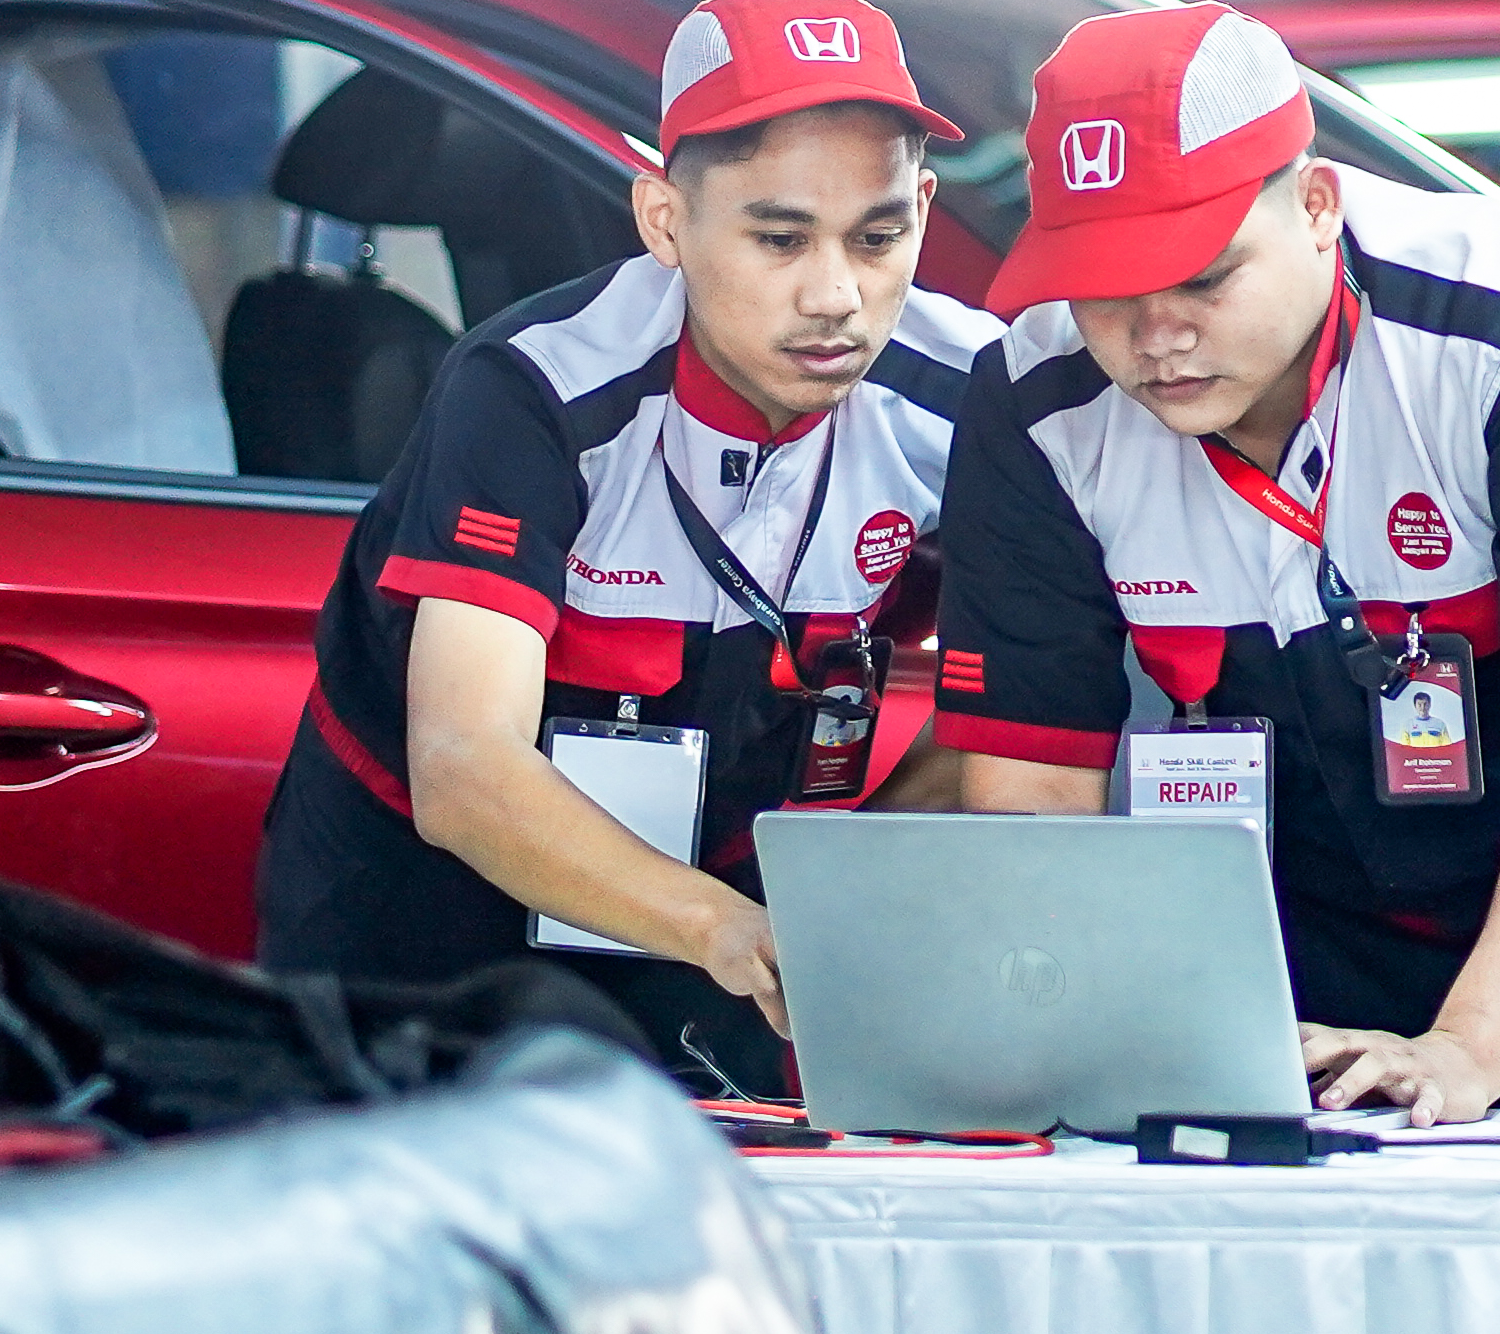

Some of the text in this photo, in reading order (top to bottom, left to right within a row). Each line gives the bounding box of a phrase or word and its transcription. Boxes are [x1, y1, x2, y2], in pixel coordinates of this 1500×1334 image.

[1262, 488, 1296, 517] Honda
[1397, 507, 1440, 522] Happy to
[1394, 522, 1447, 534] Serve You
[716, 557, 743, 588] Center
[1110, 580, 1198, 595] ONDA
